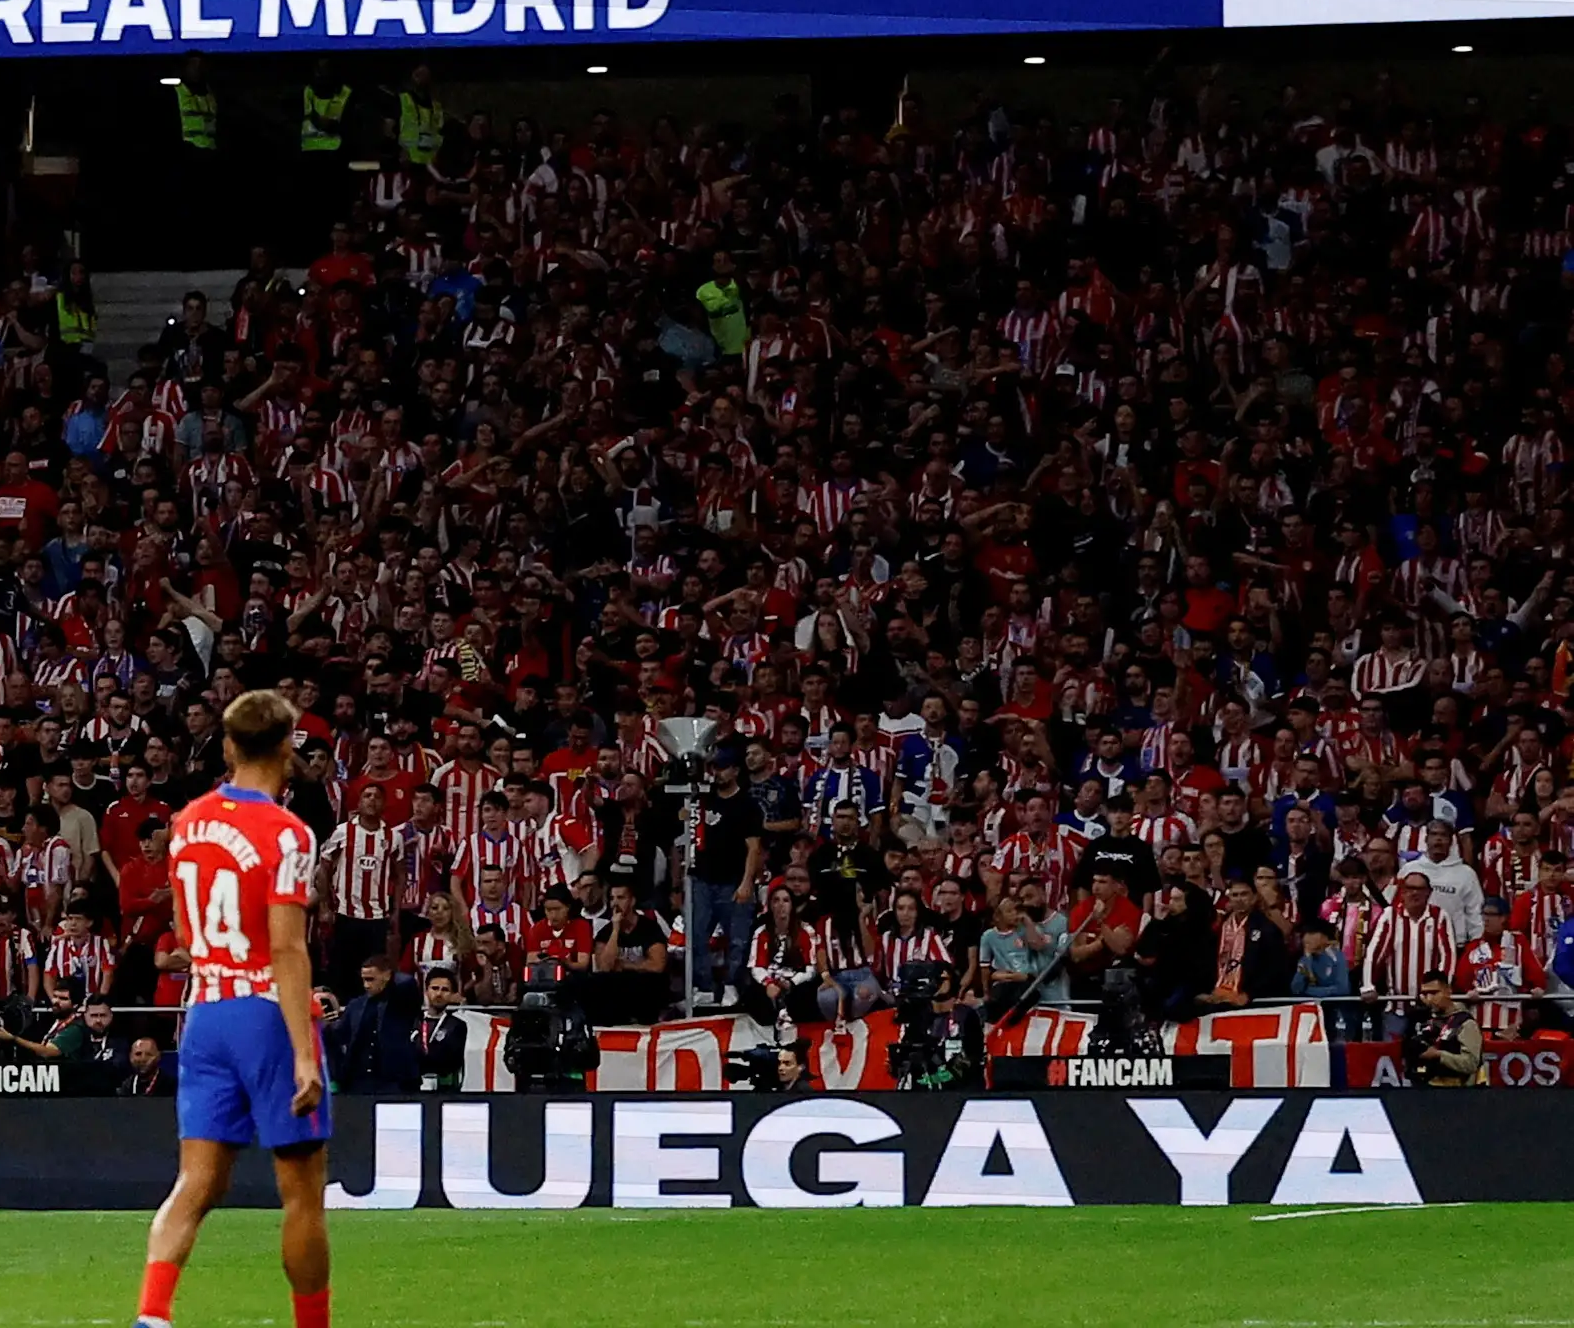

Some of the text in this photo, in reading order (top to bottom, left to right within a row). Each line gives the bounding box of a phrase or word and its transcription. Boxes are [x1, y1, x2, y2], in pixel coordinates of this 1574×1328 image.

[176, 860, 251, 963] 14
[1046, 1058, 1173, 1087] #FANCAM
[325, 1097, 1425, 1210] JUEGA YA
